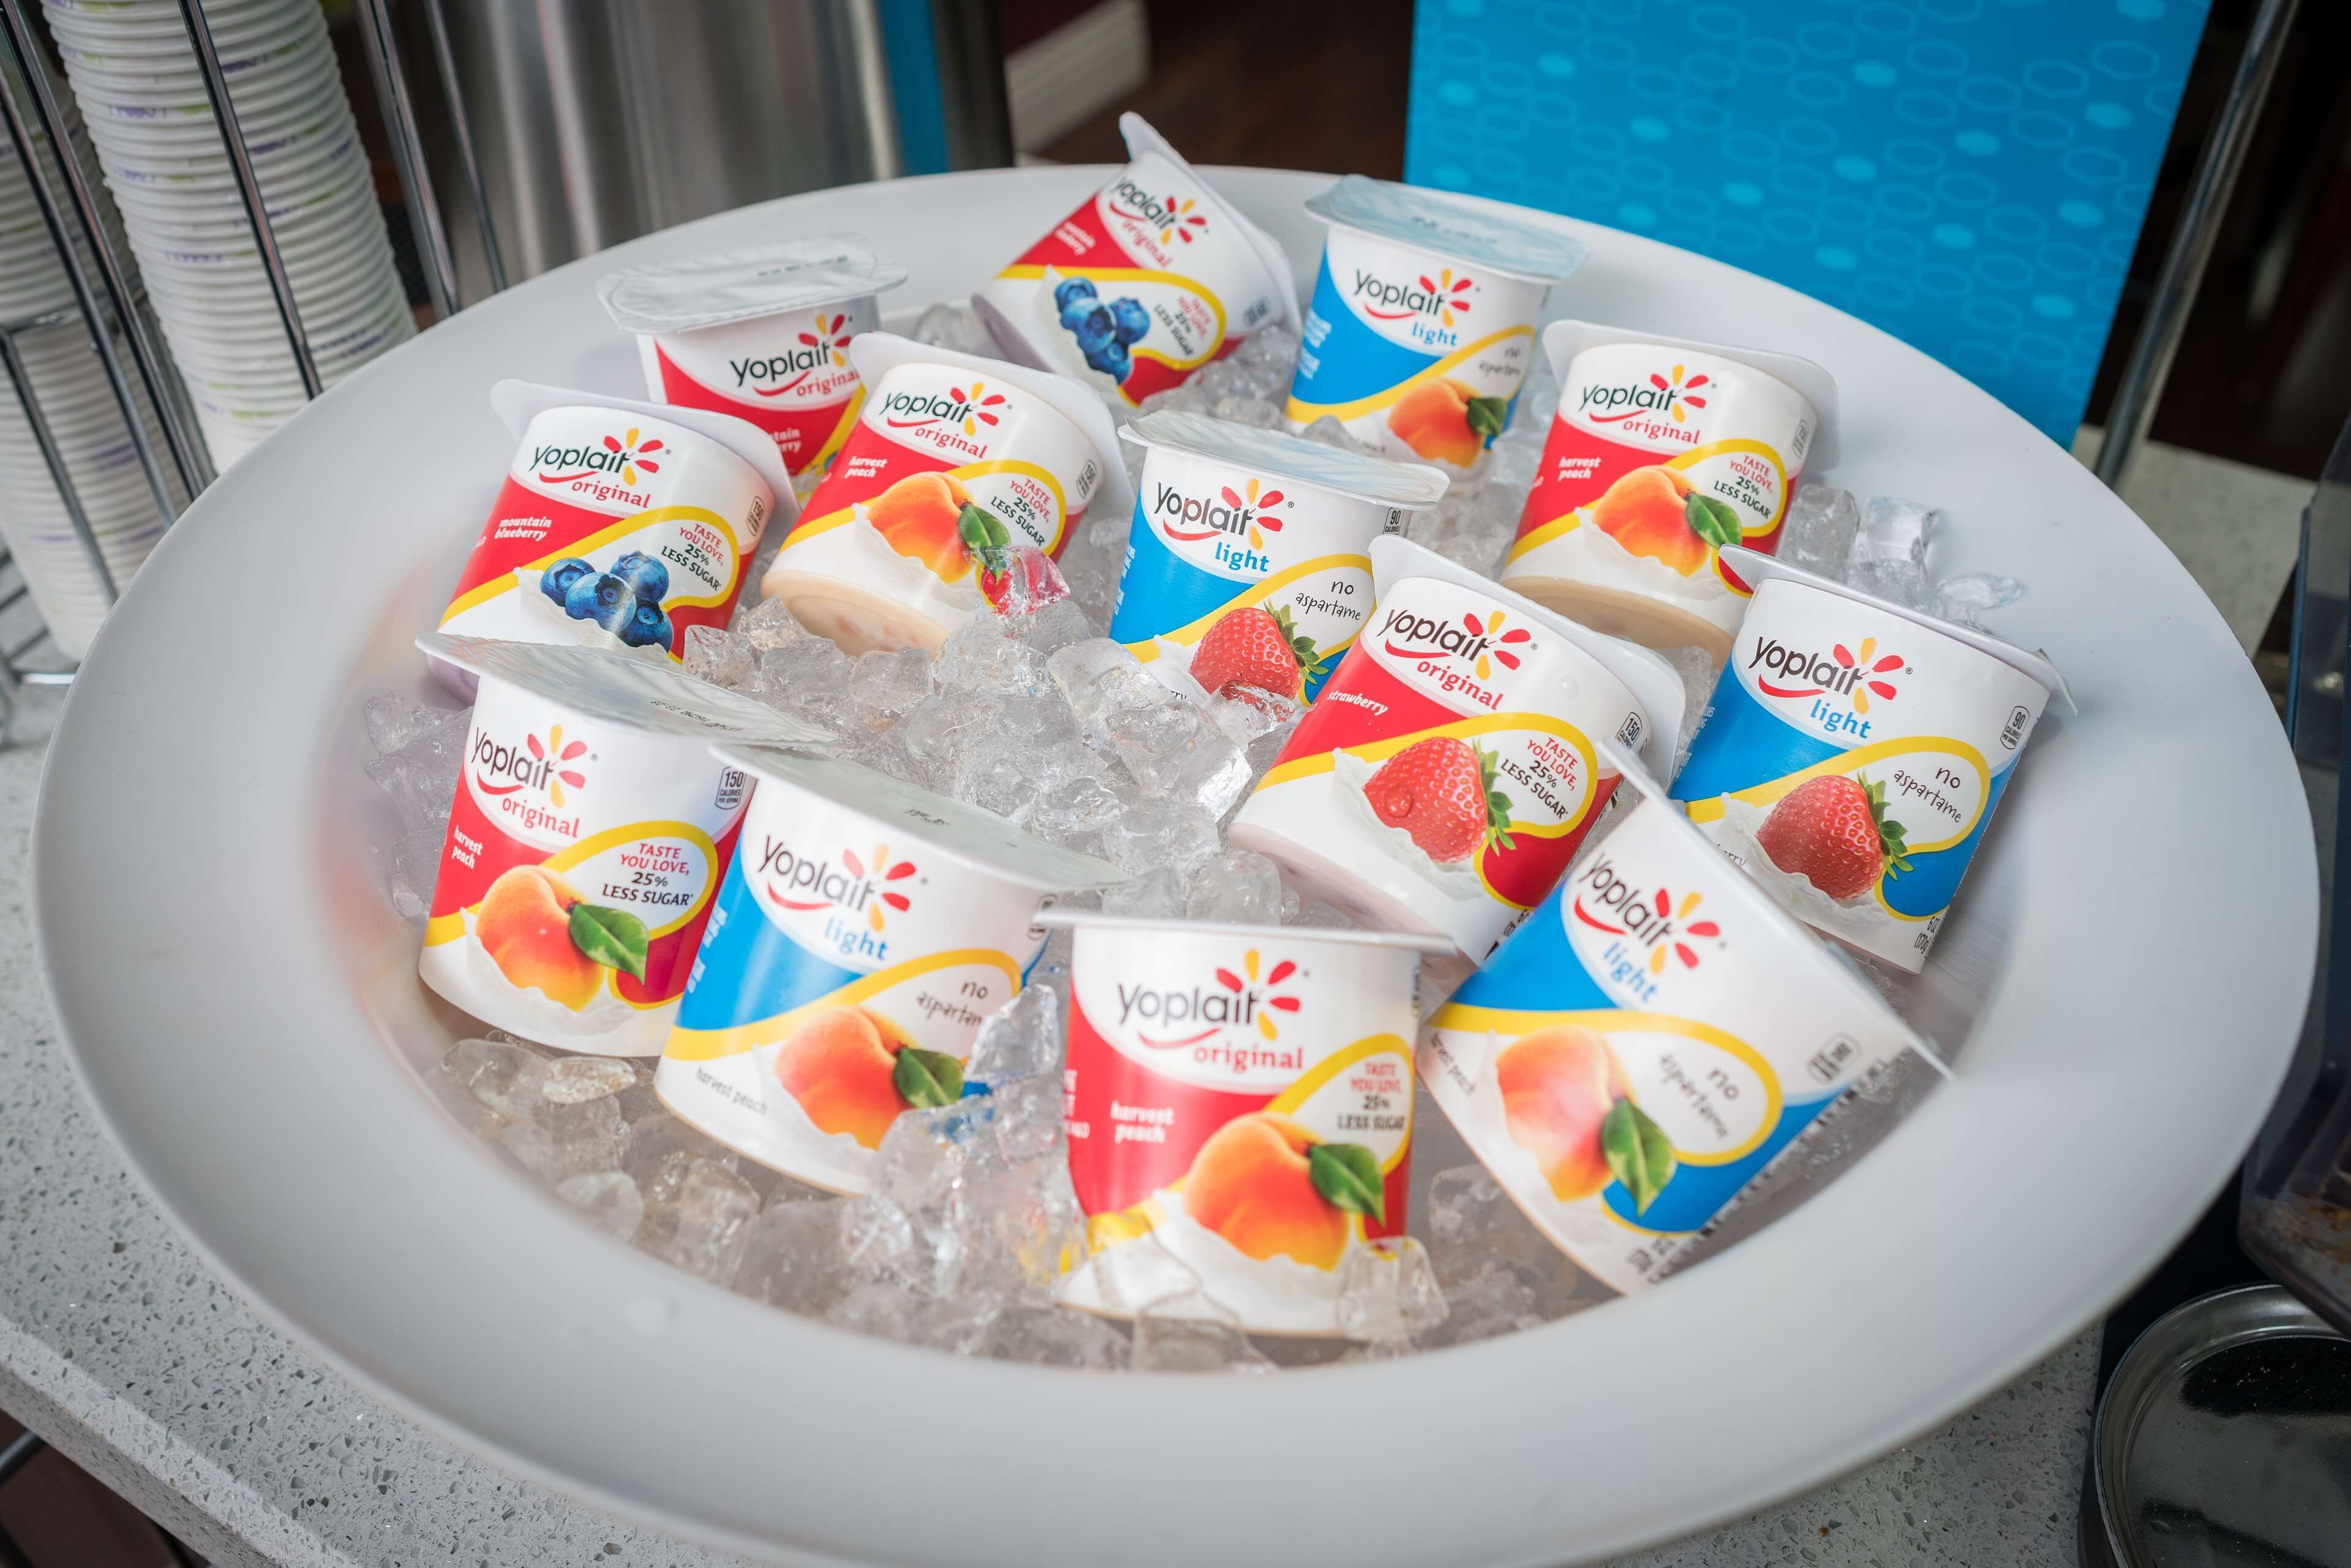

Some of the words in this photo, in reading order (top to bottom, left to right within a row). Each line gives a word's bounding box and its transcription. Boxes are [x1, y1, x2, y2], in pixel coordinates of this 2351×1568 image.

[1109, 176, 1175, 229] yoplait
[1122, 219, 1173, 268] original
[1353, 268, 1445, 316] yoplait
[1411, 323, 1458, 347] light
[729, 342, 830, 387] yoplait
[879, 391, 973, 424] yoplait
[1578, 384, 1678, 411] yoplait
[915, 426, 988, 459] original
[1624, 418, 1701, 445] original
[528, 444, 629, 473] yoplait
[849, 456, 888, 468] harvest
[1558, 456, 1602, 469] harvest
[1743, 455, 1771, 477] TASTE
[844, 467, 876, 479] peach
[1558, 467, 1592, 482] peach
[1729, 460, 1753, 479] YOU
[1749, 470, 1774, 495] LOVE,
[1736, 476, 1760, 496] 25%
[571, 481, 652, 508] original
[1010, 480, 1032, 501] YOU
[1029, 494, 1051, 523] LOVE,
[1024, 478, 1051, 505] TASTE
[1714, 480, 1741, 501] LESS
[991, 495, 1015, 521] LESS
[1013, 497, 1037, 521] 25%
[1154, 482, 1253, 536] yoplait
[1390, 510, 1401, 525] 90
[493, 527, 547, 542] blueberry
[498, 516, 552, 528] mountain
[694, 523, 723, 548] TASTE
[661, 546, 689, 568] LESS
[680, 527, 703, 546] YOU
[698, 540, 725, 566] LOVE,
[684, 544, 710, 566] 25%
[1215, 542, 1269, 572] light
[1331, 580, 1354, 596] no
[1295, 592, 1361, 621] aspartame
[1376, 609, 1491, 662] yoplait
[1749, 636, 1864, 696] yoplait
[1417, 660, 1504, 711] original
[1327, 690, 1389, 716] strawberry
[1625, 717, 1640, 741] 150
[1810, 698, 1872, 739] light
[2012, 711, 2026, 730] 90
[470, 727, 553, 790] yoplait
[1527, 739, 1551, 762] YOU
[1550, 759, 1577, 791] LOVE,
[1545, 737, 1578, 770] TASTE
[725, 771, 744, 787] 150
[1501, 758, 1532, 786] LESS
[1529, 760, 1558, 788] 25%
[1936, 767, 1960, 790] no
[1893, 768, 1962, 823] aspartame
[502, 797, 579, 838] original
[454, 825, 483, 855] harvest
[639, 842, 682, 859] TASTE
[452, 845, 475, 869] peach
[620, 854, 650, 870] YOU
[651, 858, 689, 876] LOVE,
[631, 872, 668, 887] 25%
[757, 835, 876, 912] yoplait
[602, 884, 637, 901] LESS
[1577, 852, 1672, 948] yoplait
[823, 917, 889, 961] light
[1603, 940, 1659, 1003] light
[961, 980, 988, 1000] no
[915, 991, 982, 1027] aspartam
[1117, 983, 1259, 1027] yoplait
[1194, 1045, 1303, 1073] original
[696, 1065, 733, 1100] harvest
[732, 1087, 768, 1116] peach
[1659, 1051, 1729, 1141] aspartame
[1709, 1068, 1739, 1101] no
[1110, 1100, 1174, 1125] harvest
[1362, 1095, 1390, 1111] 25%
[1114, 1125, 1166, 1144] peach
[1338, 1114, 1369, 1130] LESS
